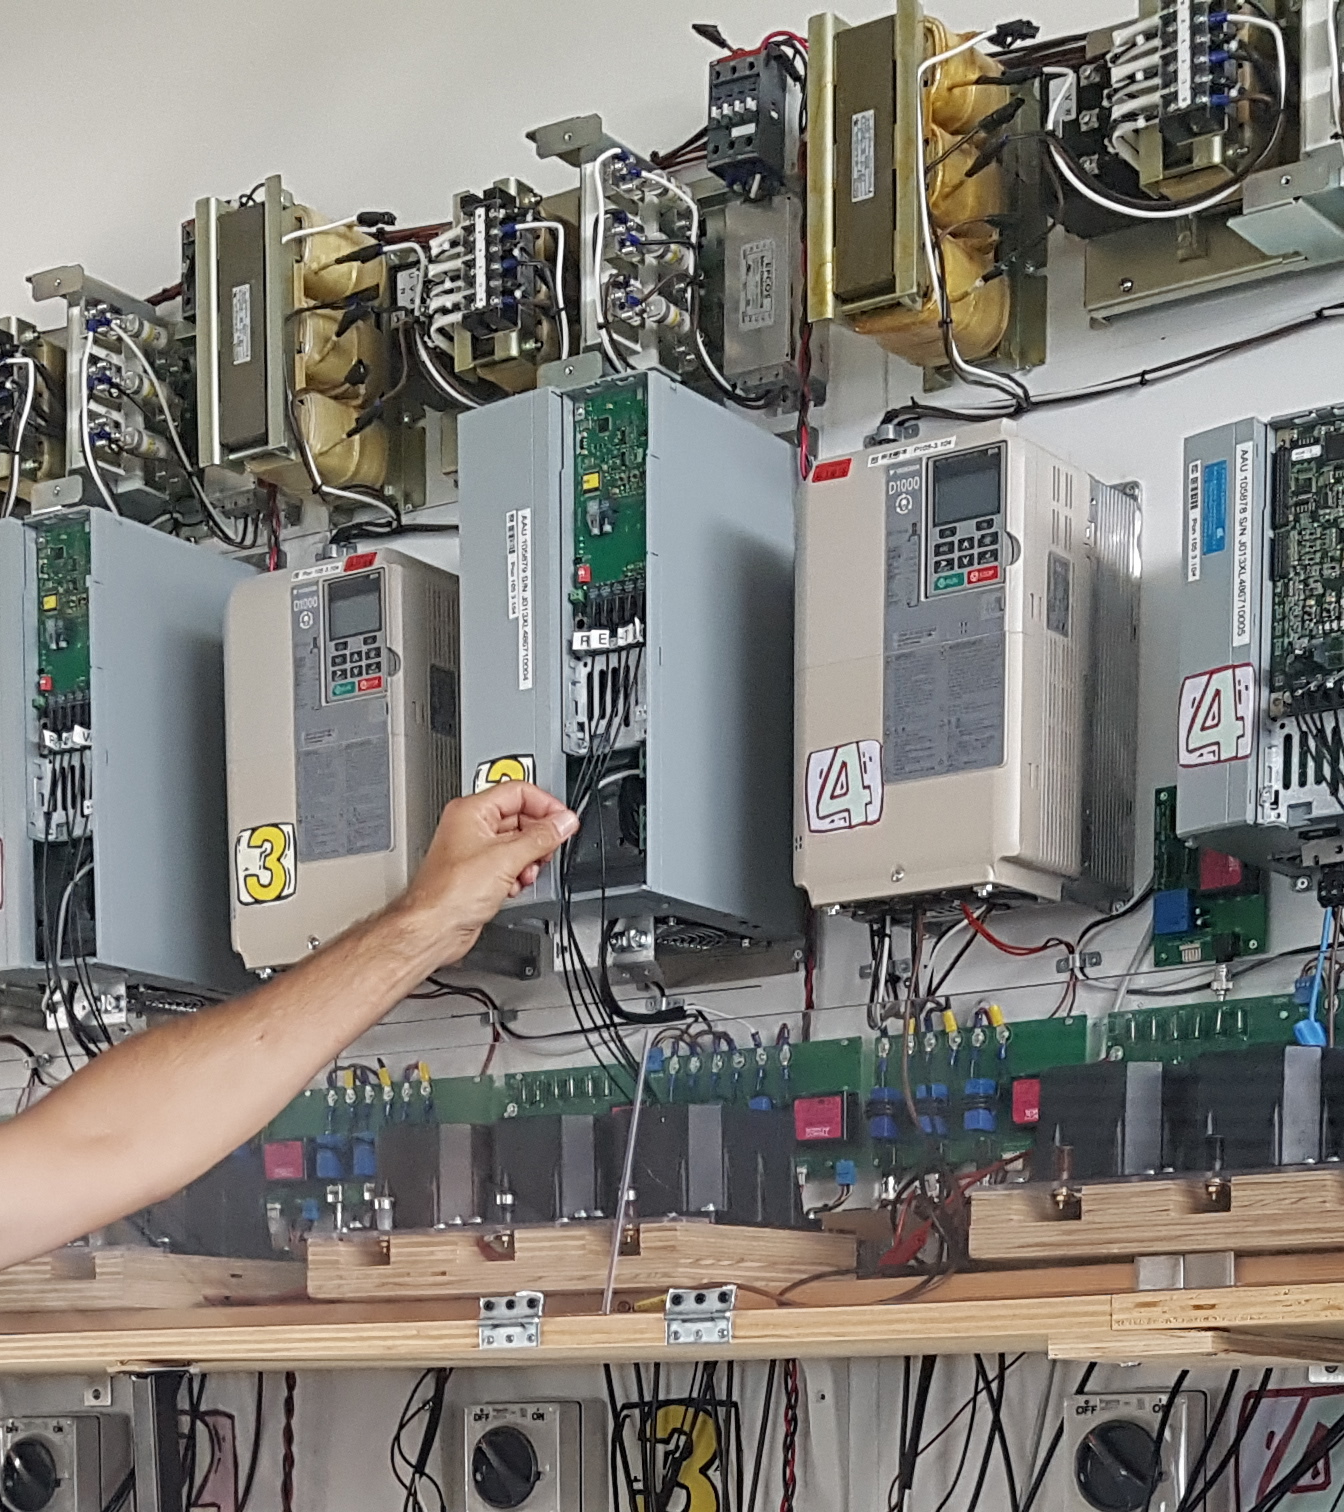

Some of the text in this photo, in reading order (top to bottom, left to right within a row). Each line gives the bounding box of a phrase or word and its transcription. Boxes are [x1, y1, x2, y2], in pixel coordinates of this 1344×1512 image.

[1239, 448, 1248, 473] AAU
[888, 476, 920, 495] D1000
[521, 514, 529, 536] AAU
[1238, 516, 1247, 536] S/N
[1186, 664, 1244, 762] 4
[816, 740, 872, 828] 4
[244, 825, 287, 902] 3
[1075, 1405, 1097, 1415] OFF
